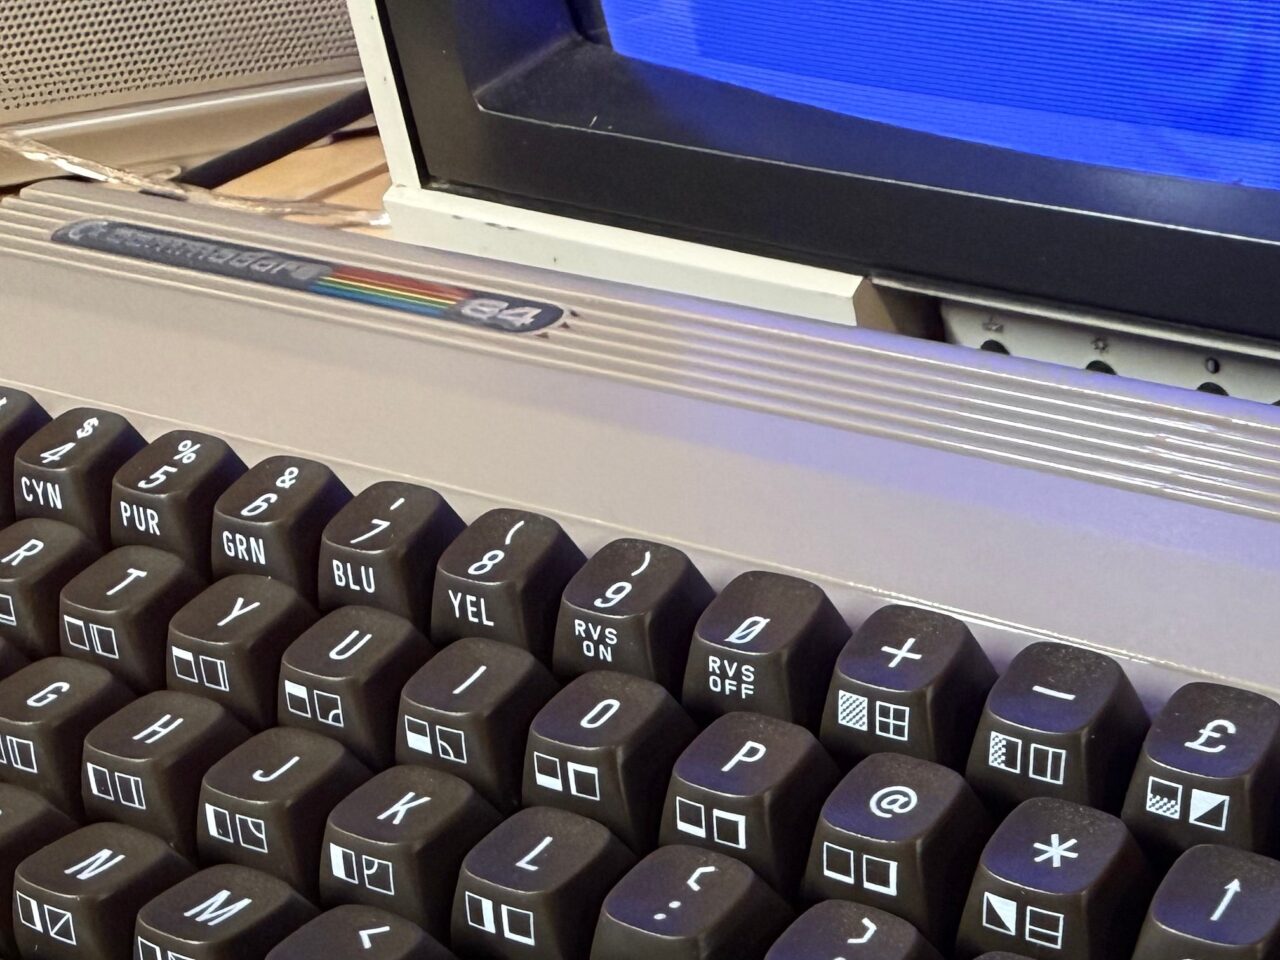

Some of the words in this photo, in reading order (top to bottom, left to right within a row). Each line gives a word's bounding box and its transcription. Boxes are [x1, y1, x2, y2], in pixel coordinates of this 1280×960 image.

[460, 297, 543, 328] 64
[76, 417, 99, 439] $
[39, 442, 76, 464] 4
[173, 439, 201, 464] %
[137, 465, 178, 489] 5
[275, 466, 299, 489] &
[20, 476, 63, 510] CYN
[240, 492, 278, 517] 6
[119, 500, 161, 536] PUR
[350, 518, 391, 544] 7
[0, 538, 45, 566] R
[222, 530, 266, 565] GRN
[467, 549, 505, 575] 8
[106, 567, 148, 596] T
[331, 558, 376, 594] BLU
[448, 589, 495, 627] YEL
[593, 581, 633, 608] 9
[217, 597, 261, 627] Y
[328, 629, 373, 660] U
[573, 618, 618, 645] RVS
[581, 639, 613, 663] ON
[880, 637, 923, 668] +
[707, 654, 755, 683] RVS
[26, 681, 71, 707] G
[708, 674, 755, 700] OFF
[132, 713, 184, 744] H
[579, 698, 621, 729] O
[1184, 718, 1237, 753] £
[252, 755, 300, 782] J
[721, 740, 767, 772] P
[376, 791, 432, 825] K
[869, 785, 918, 819] @
[63, 848, 126, 880] N
[515, 836, 553, 871] L
[183, 889, 253, 926] M
